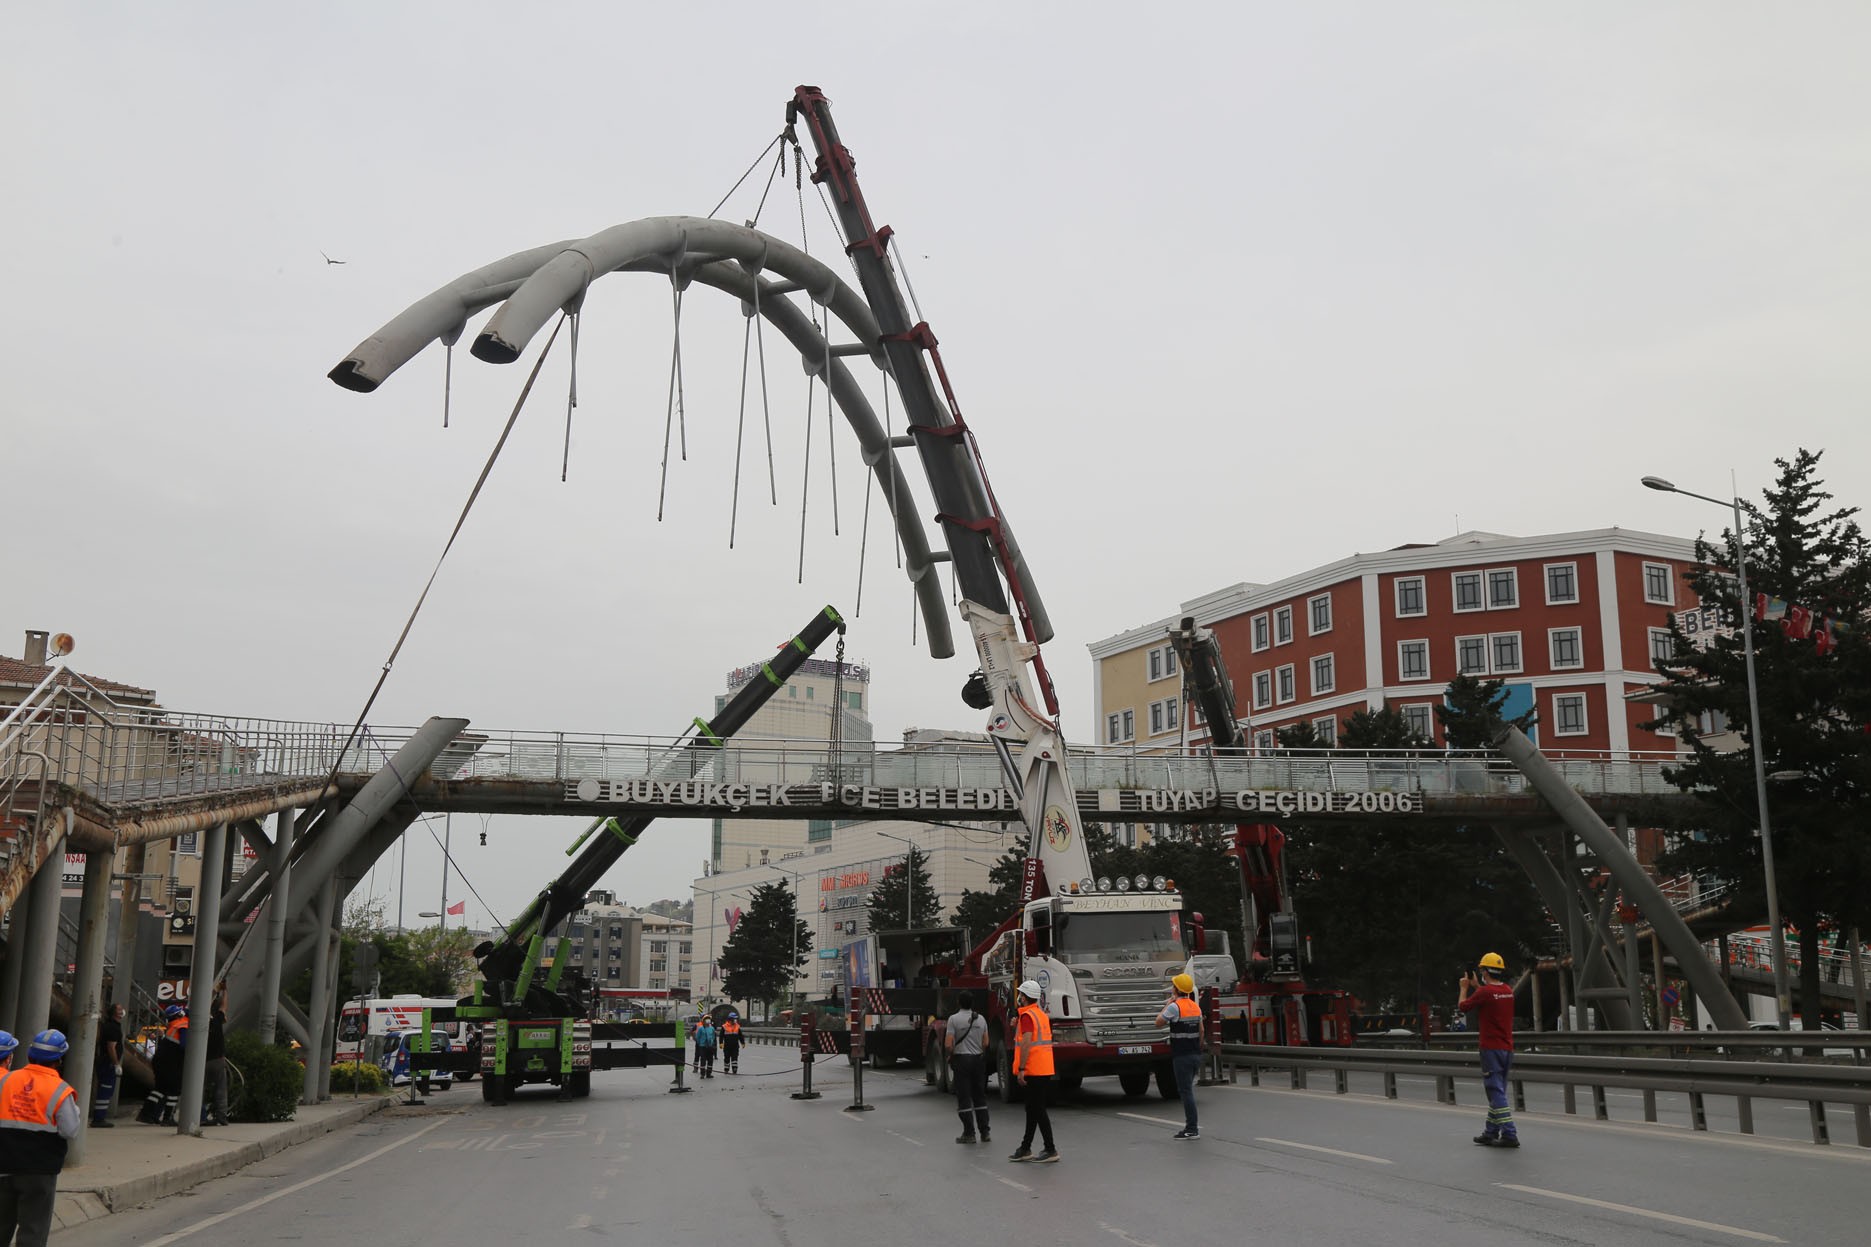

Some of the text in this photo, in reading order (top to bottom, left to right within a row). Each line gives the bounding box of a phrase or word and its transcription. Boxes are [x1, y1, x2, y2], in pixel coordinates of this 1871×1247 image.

[1134, 785, 1216, 812] TÜYAP
[1236, 786, 1333, 818] GEÇİDİ
[1344, 791, 1413, 812] 2006
[1024, 860, 1036, 901] 135 TON
[1103, 966, 1154, 977] SCANIA
